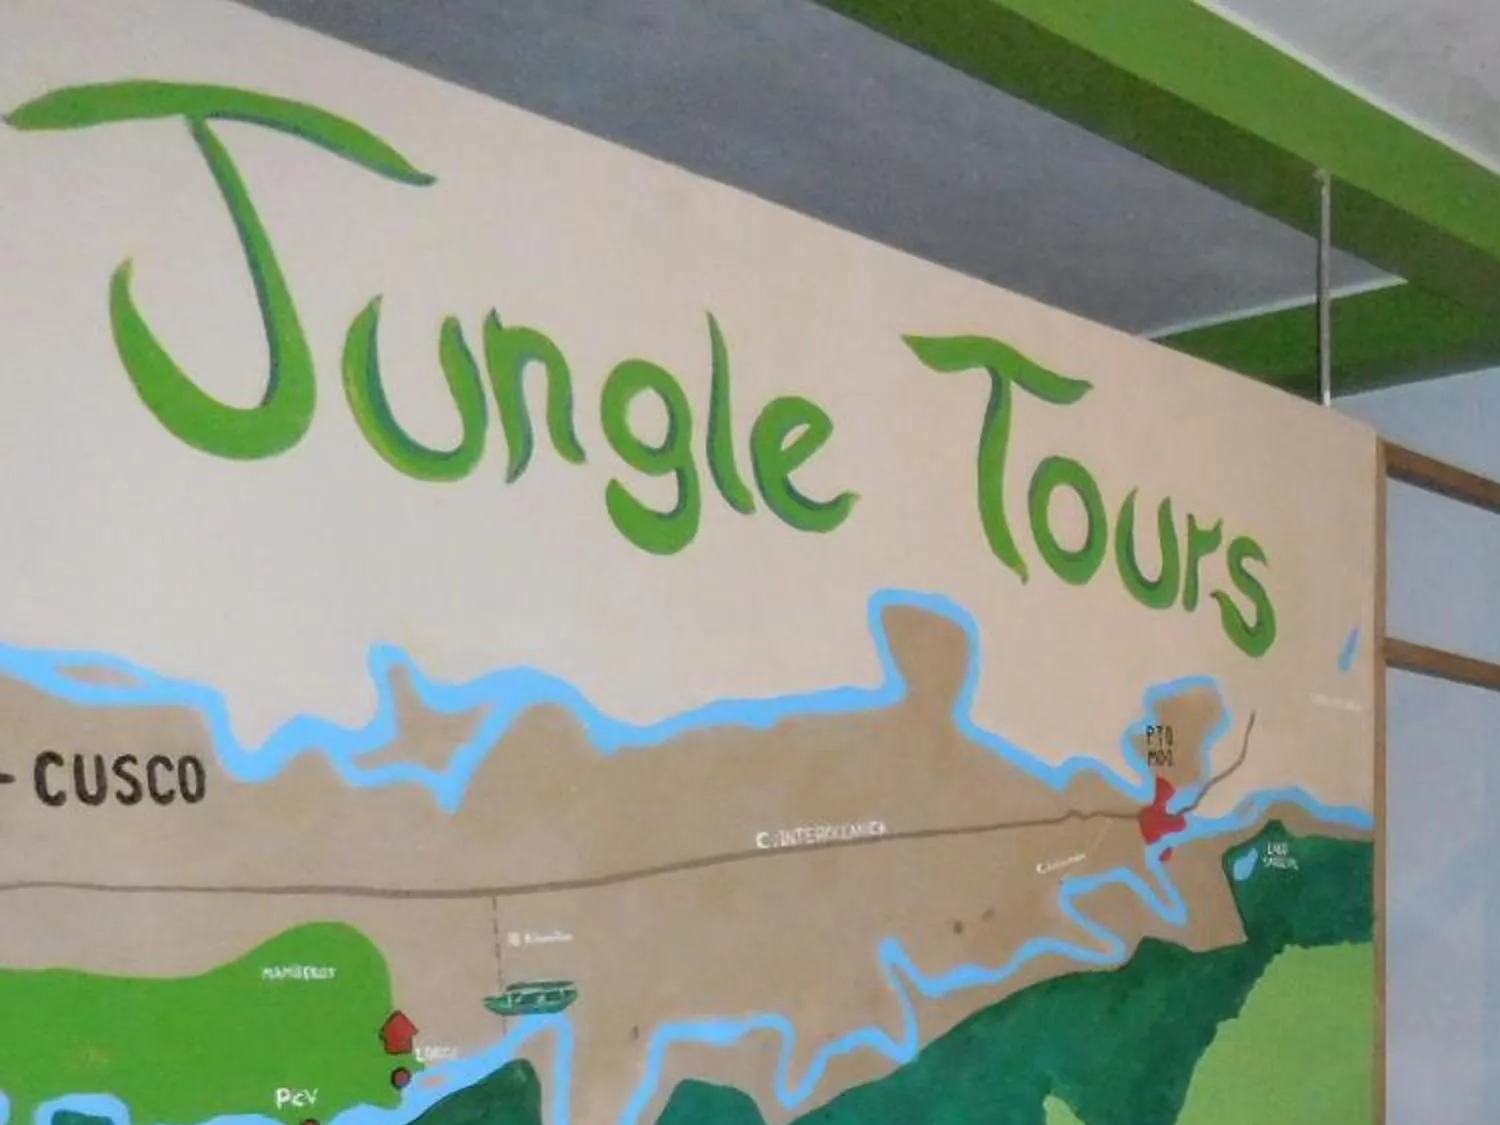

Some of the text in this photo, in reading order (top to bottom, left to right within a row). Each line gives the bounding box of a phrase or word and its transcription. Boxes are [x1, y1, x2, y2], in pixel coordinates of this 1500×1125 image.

[2, 78, 1278, 658] Jungle Tours
[33, 750, 208, 807] CUSCO
